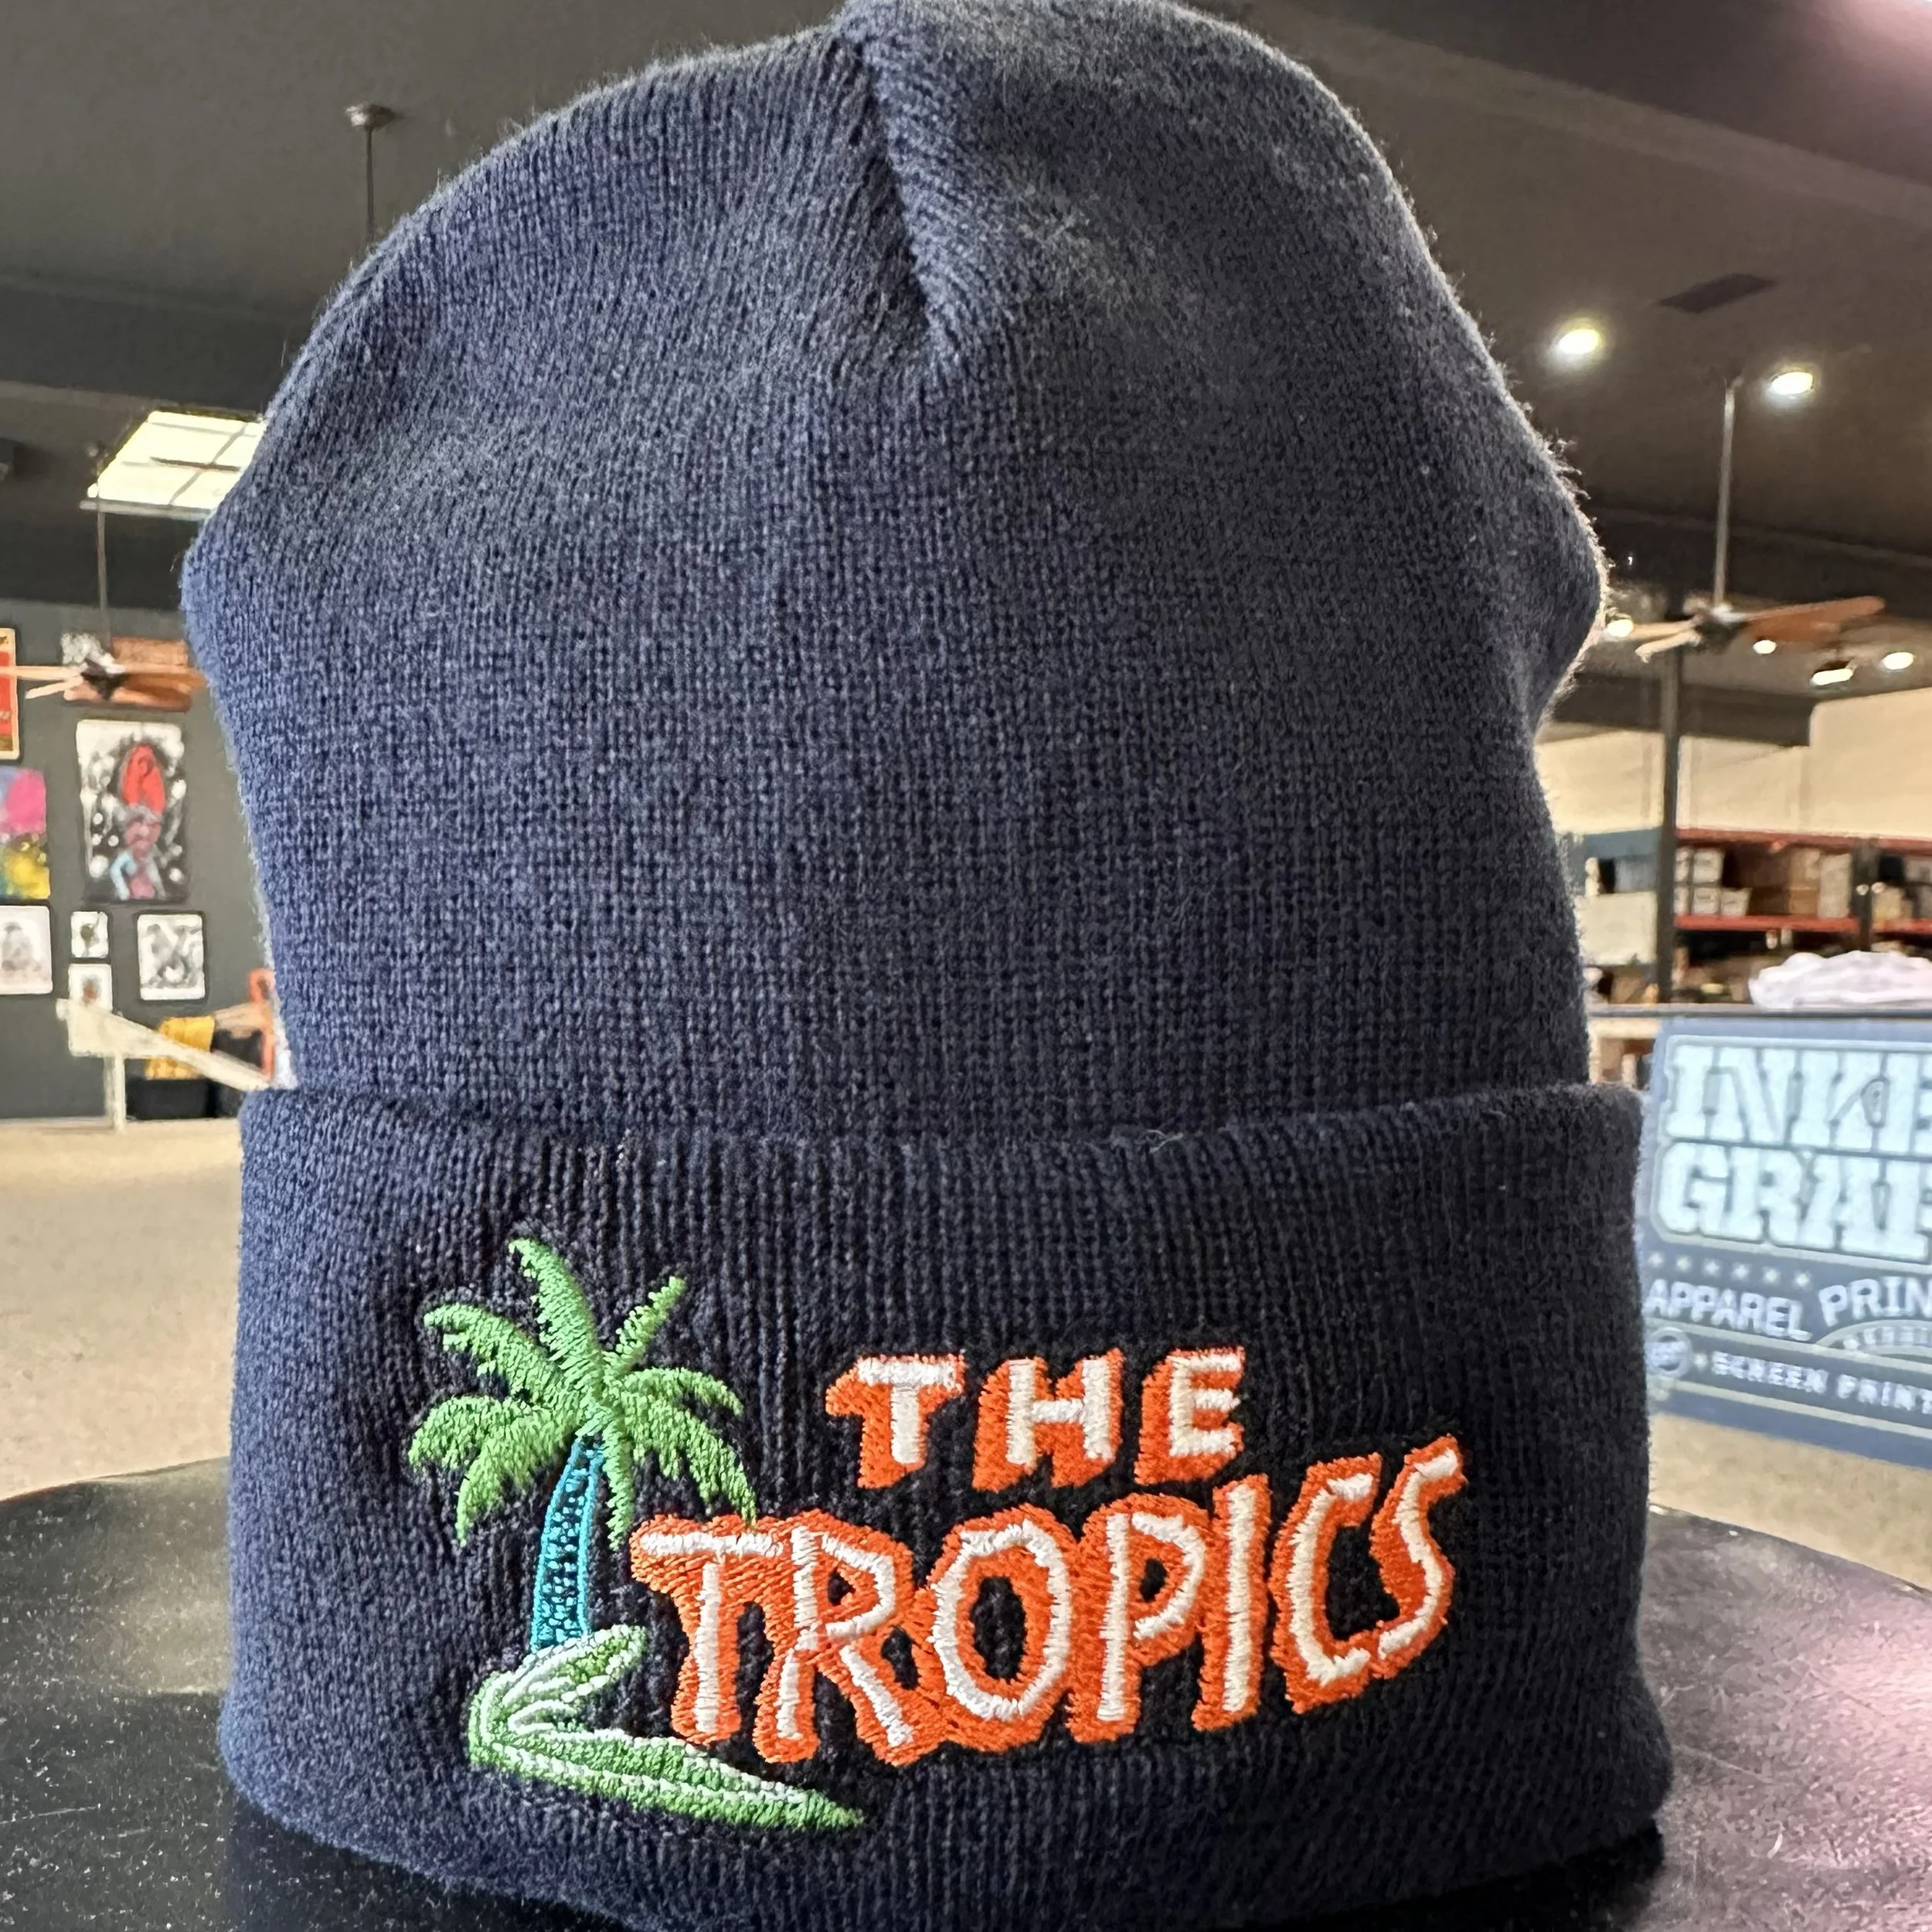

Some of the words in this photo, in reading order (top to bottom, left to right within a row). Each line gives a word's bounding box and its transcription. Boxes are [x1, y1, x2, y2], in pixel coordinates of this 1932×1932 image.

[1641, 1278, 1812, 1342] APPAREL
[825, 1347, 1245, 1492] THE
[1711, 1352, 1829, 1395] SCREEN
[630, 1435, 1468, 1766] TROPICS
